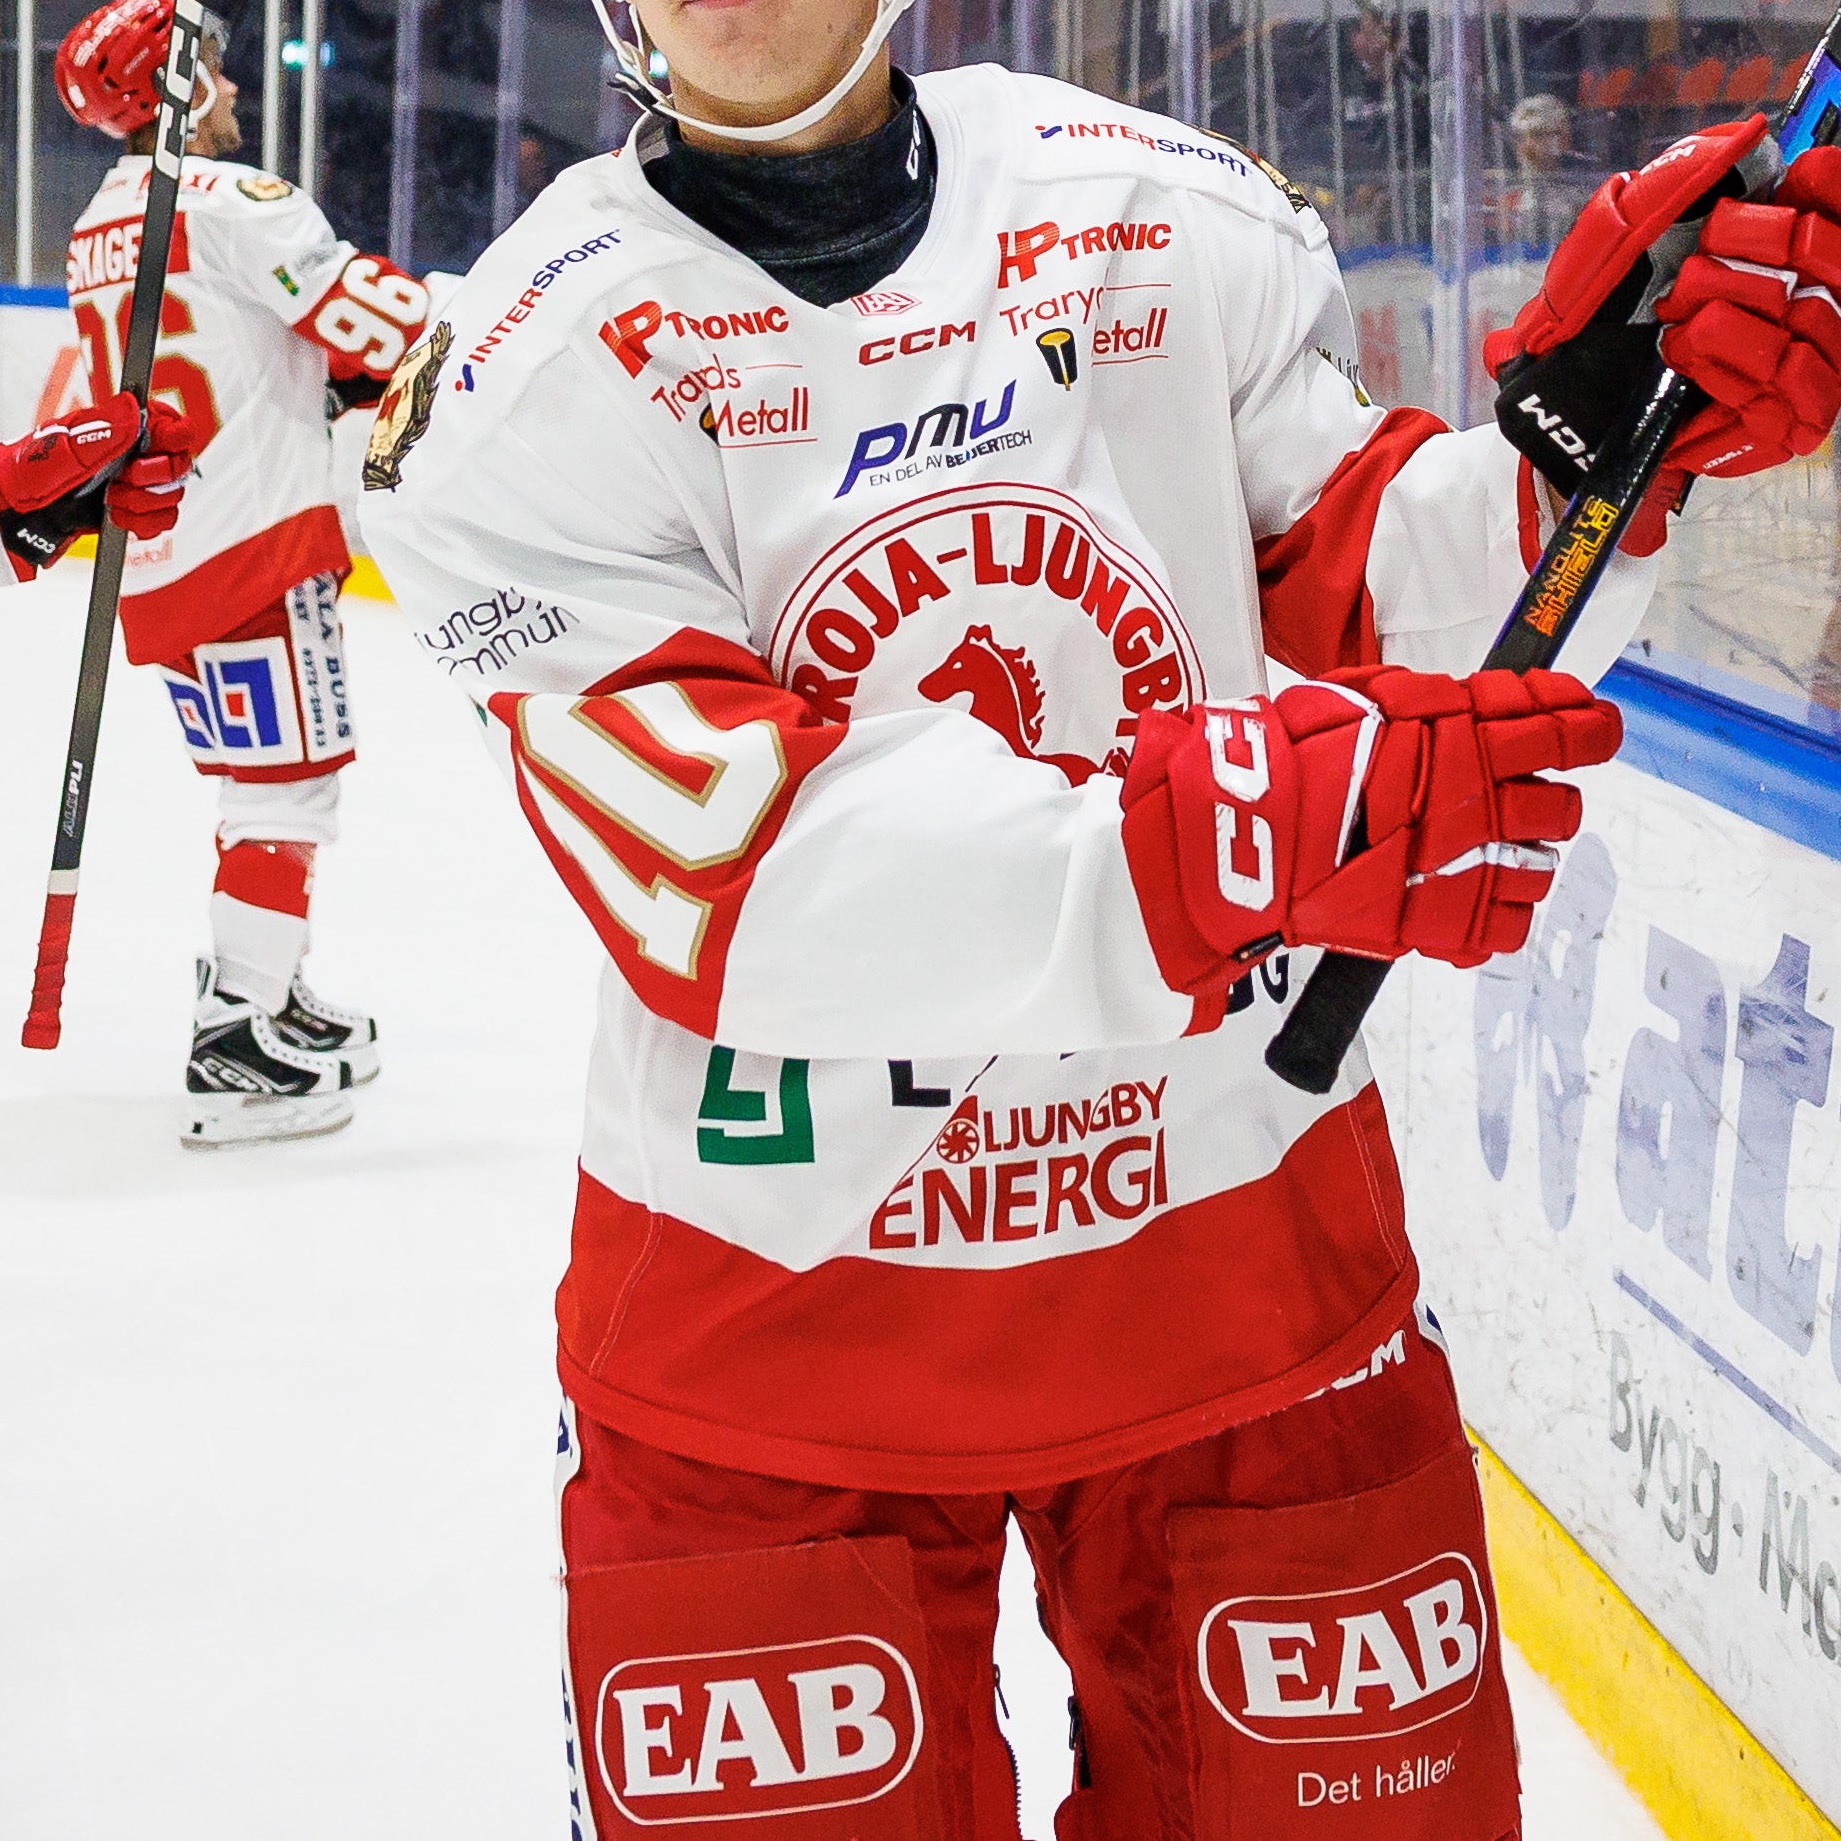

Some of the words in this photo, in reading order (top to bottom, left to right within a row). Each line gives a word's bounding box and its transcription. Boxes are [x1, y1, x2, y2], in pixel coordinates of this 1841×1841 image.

[1067, 122, 1251, 178] INTERSPORT
[316, 256, 430, 368] 96
[469, 227, 624, 365] INTERSPORT
[1092, 308, 1170, 355] etall
[857, 320, 976, 367] CCM
[716, 387, 810, 440] Metall
[869, 472, 892, 488] EN
[894, 462, 924, 485] DEL
[924, 454, 944, 473] AV
[16, 527, 57, 556] CCM
[325, 657, 351, 739] BUSS
[514, 680, 789, 980] 10
[982, 1074, 1169, 1155] LJUNGBY
[868, 1126, 1170, 1252] ENERGI
[1226, 1578, 1479, 1720] EAB
[611, 1662, 899, 1798] EAB
[1296, 1770, 1362, 1810] Det
